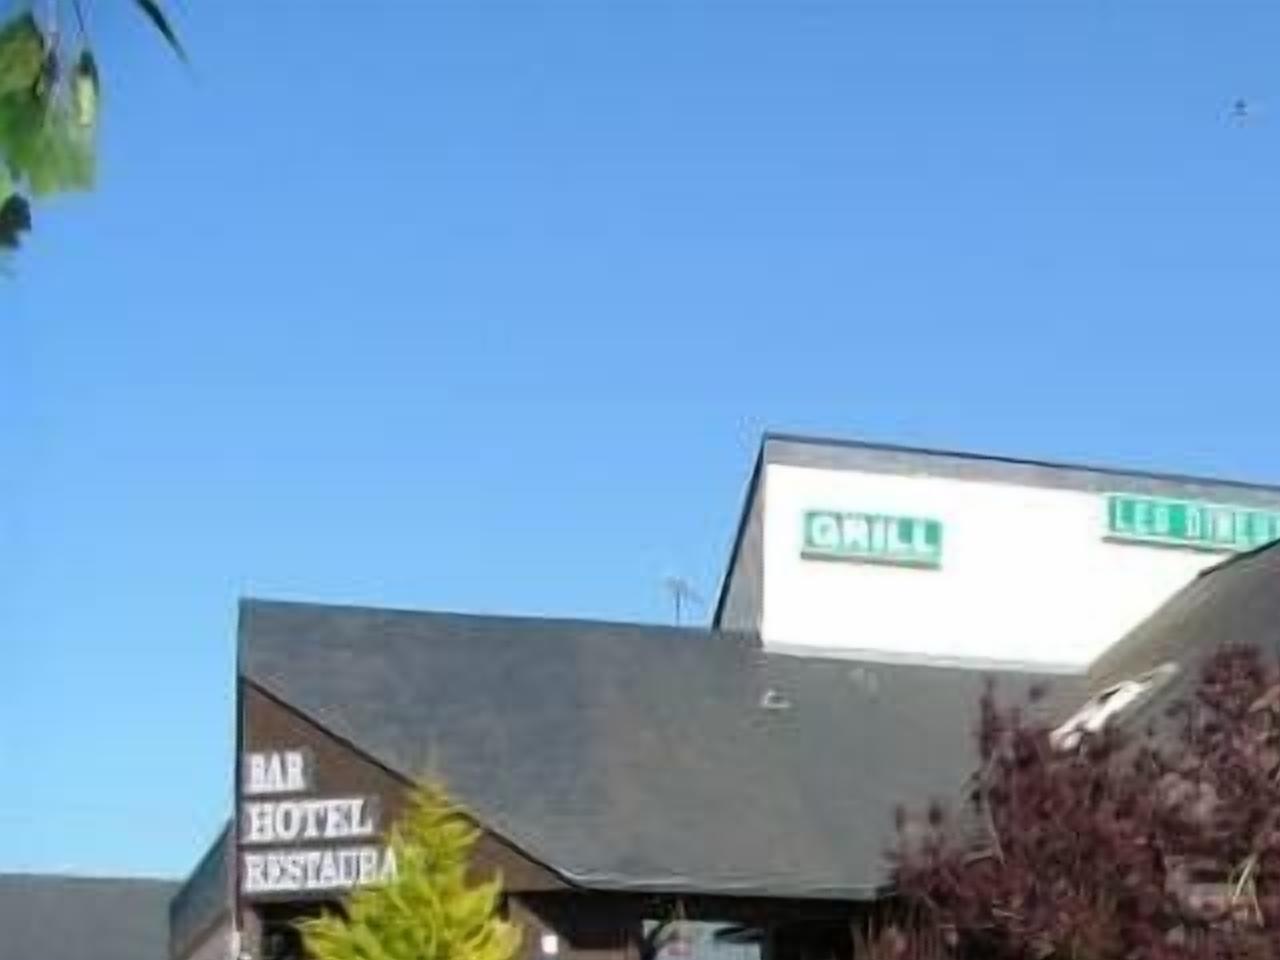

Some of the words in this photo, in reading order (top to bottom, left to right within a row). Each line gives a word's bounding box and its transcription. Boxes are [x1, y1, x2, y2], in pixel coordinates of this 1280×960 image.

[811, 515, 938, 552] GRILL
[249, 752, 304, 791] BAR
[248, 799, 373, 841] HOTEL
